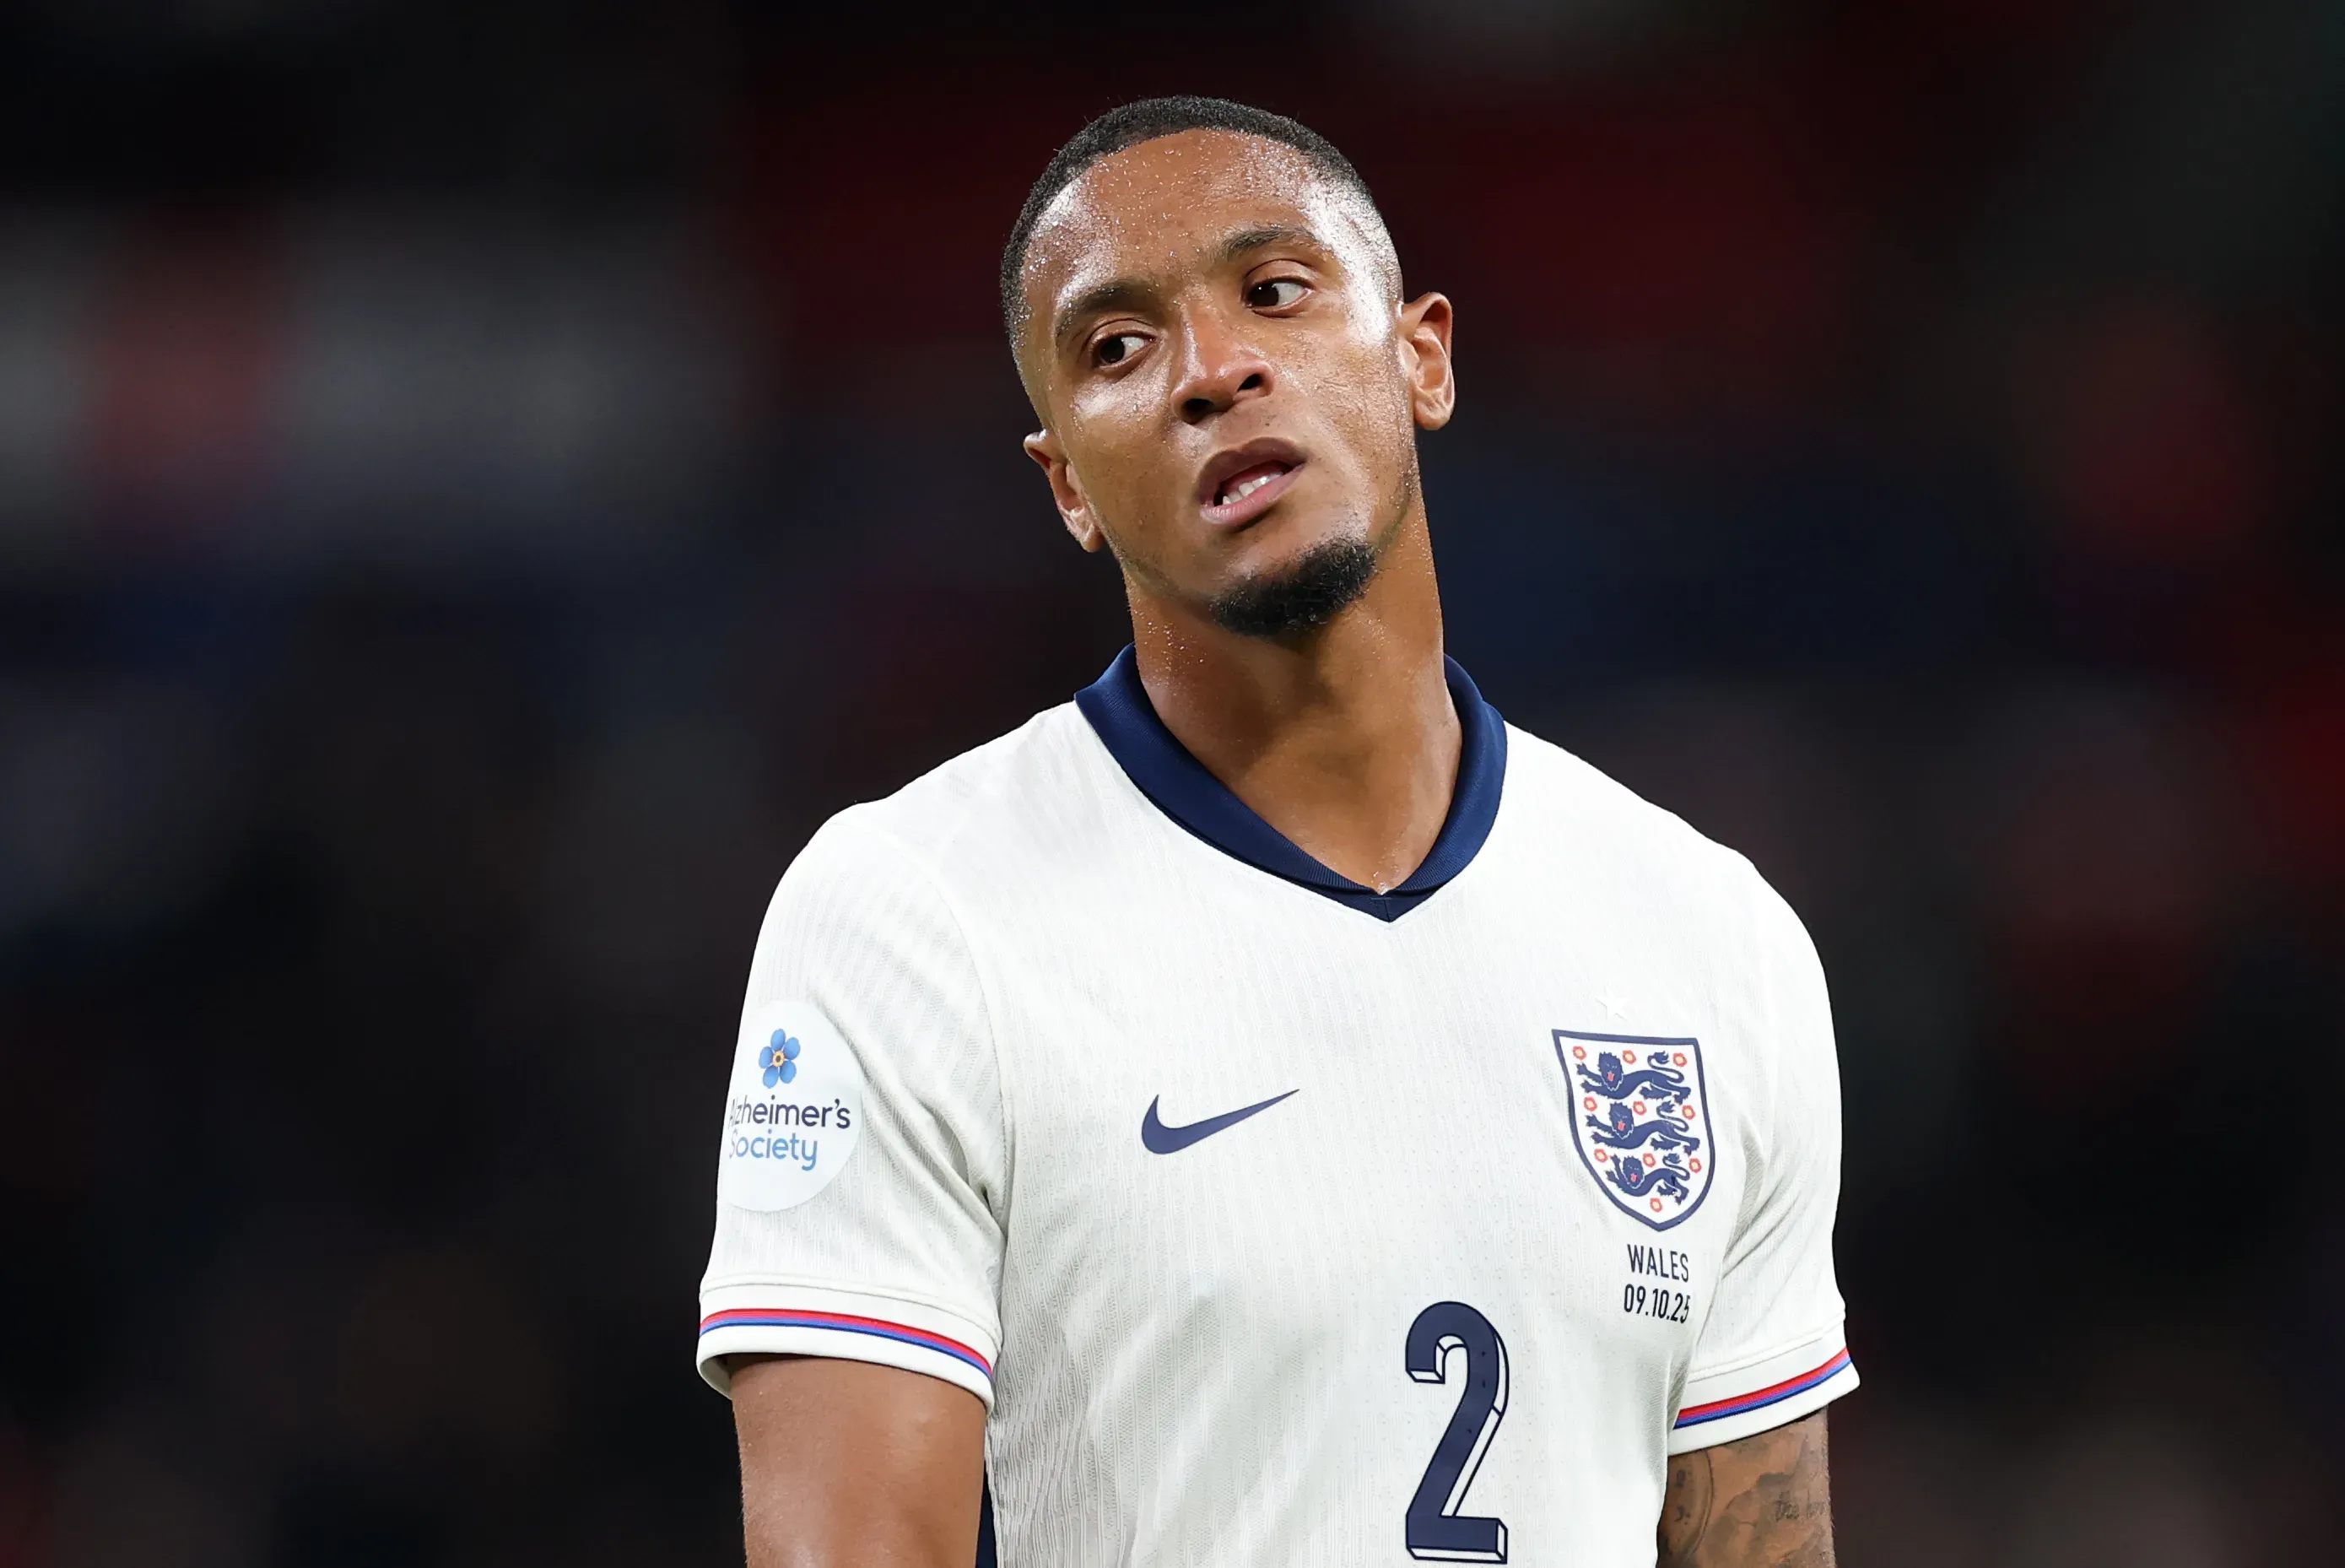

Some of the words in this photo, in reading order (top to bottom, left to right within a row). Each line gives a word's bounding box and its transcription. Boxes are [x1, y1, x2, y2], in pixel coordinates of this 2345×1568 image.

[729, 1128, 818, 1171] Society
[1627, 1244, 1689, 1282] WALES
[1624, 1284, 1691, 1324] 09.10.25
[1405, 1300, 1510, 1565] 2
